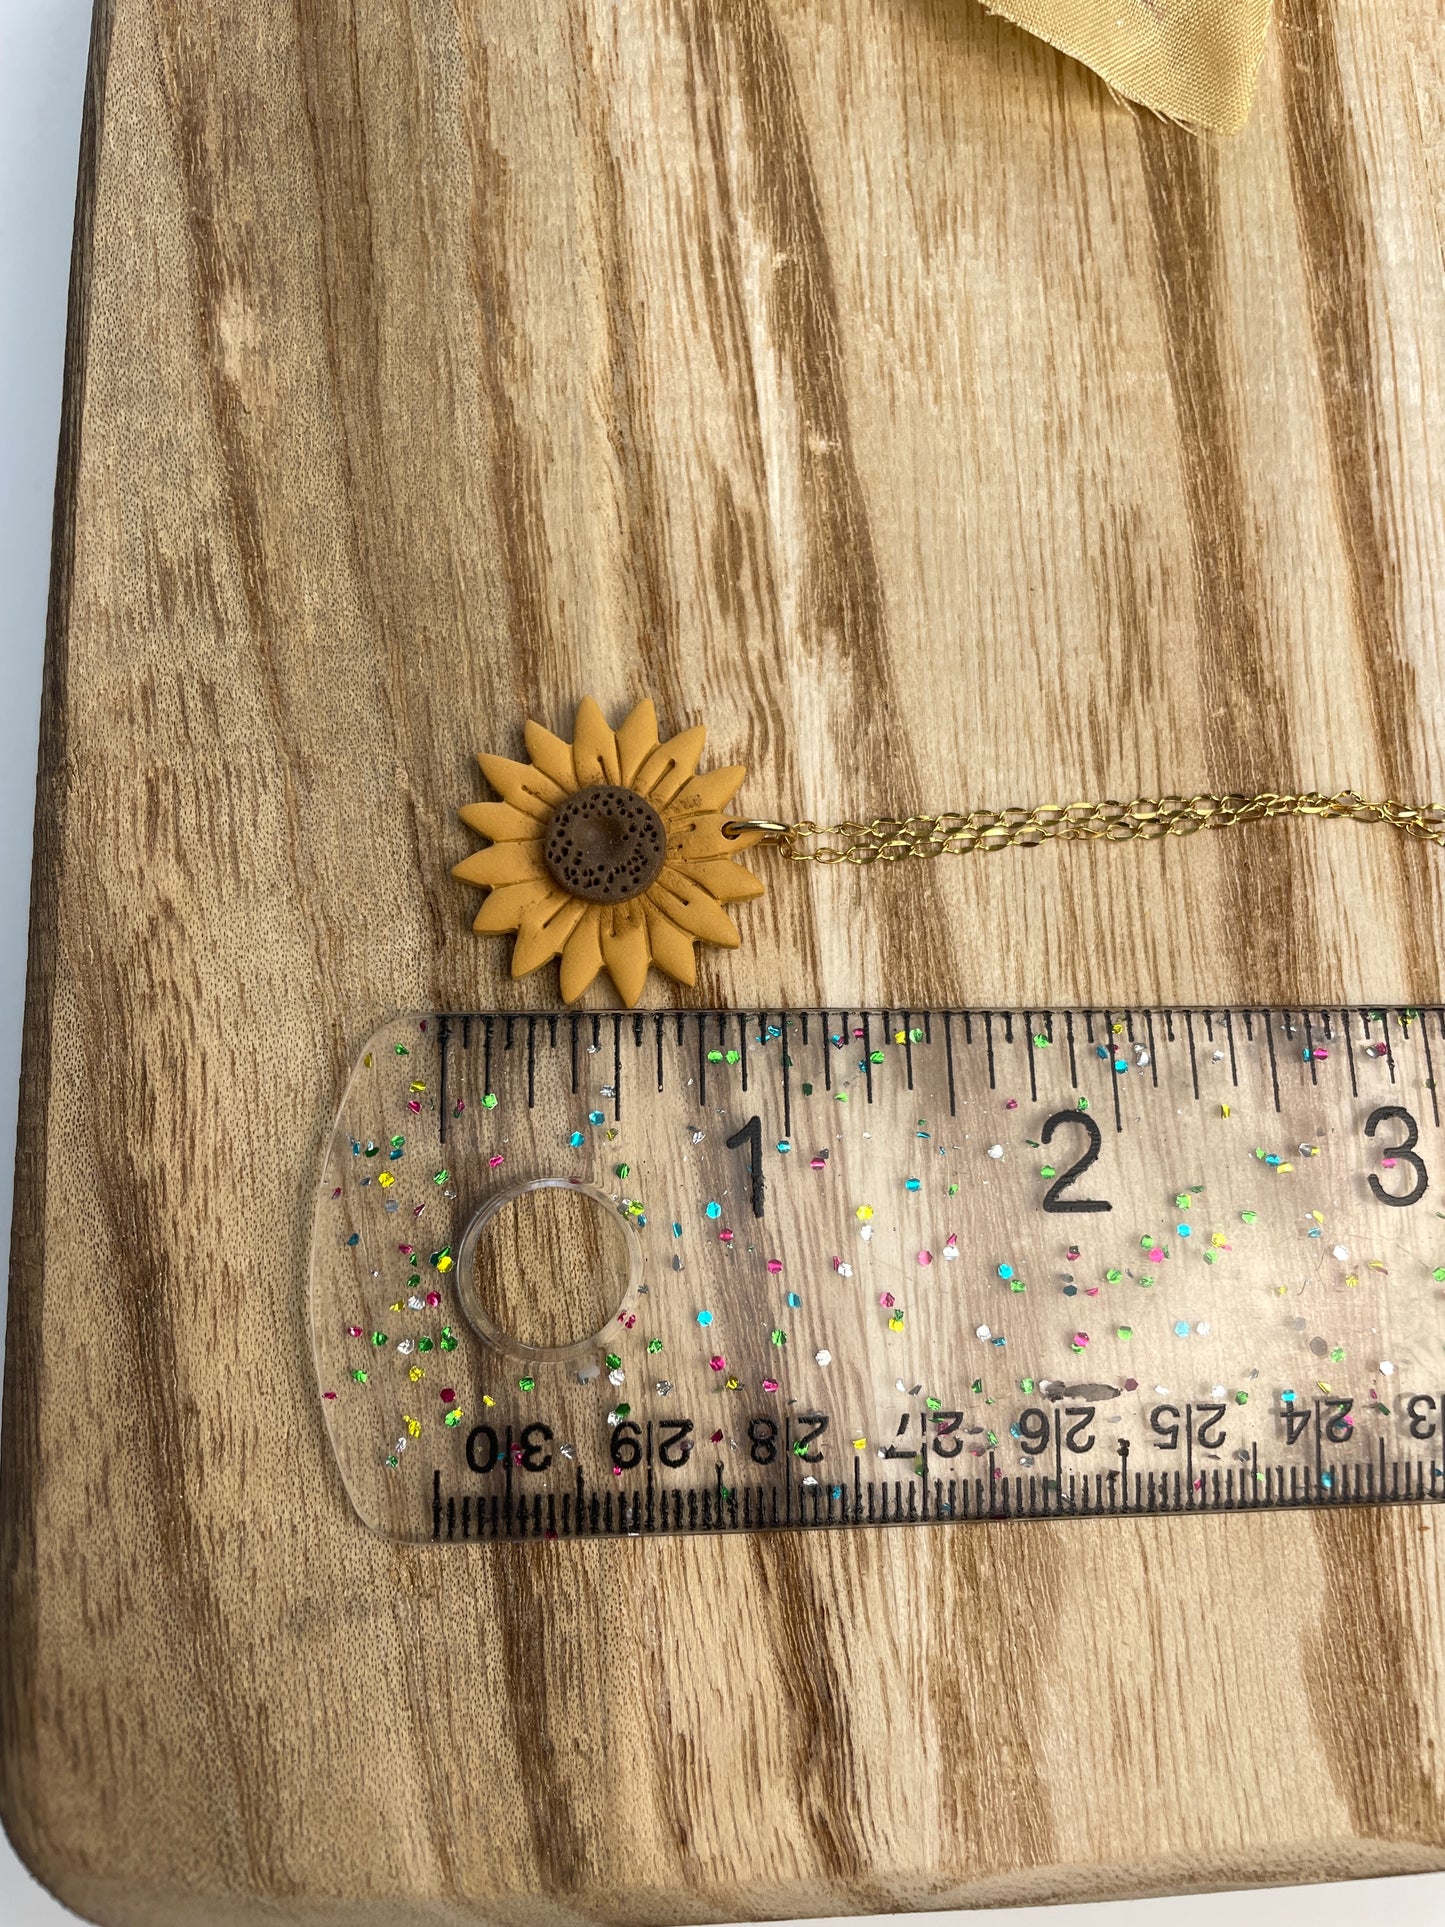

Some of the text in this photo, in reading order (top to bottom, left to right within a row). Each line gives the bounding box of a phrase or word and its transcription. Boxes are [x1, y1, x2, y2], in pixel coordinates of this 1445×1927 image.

[726, 1106, 1428, 1218] 1 2 3
[610, 1419, 695, 1469] 29
[749, 1416, 830, 1464] 28
[1018, 1405, 1096, 1455] 26
[1149, 1403, 1228, 1450] 25
[1280, 1398, 1354, 1445] 24
[466, 1422, 554, 1474] 30
